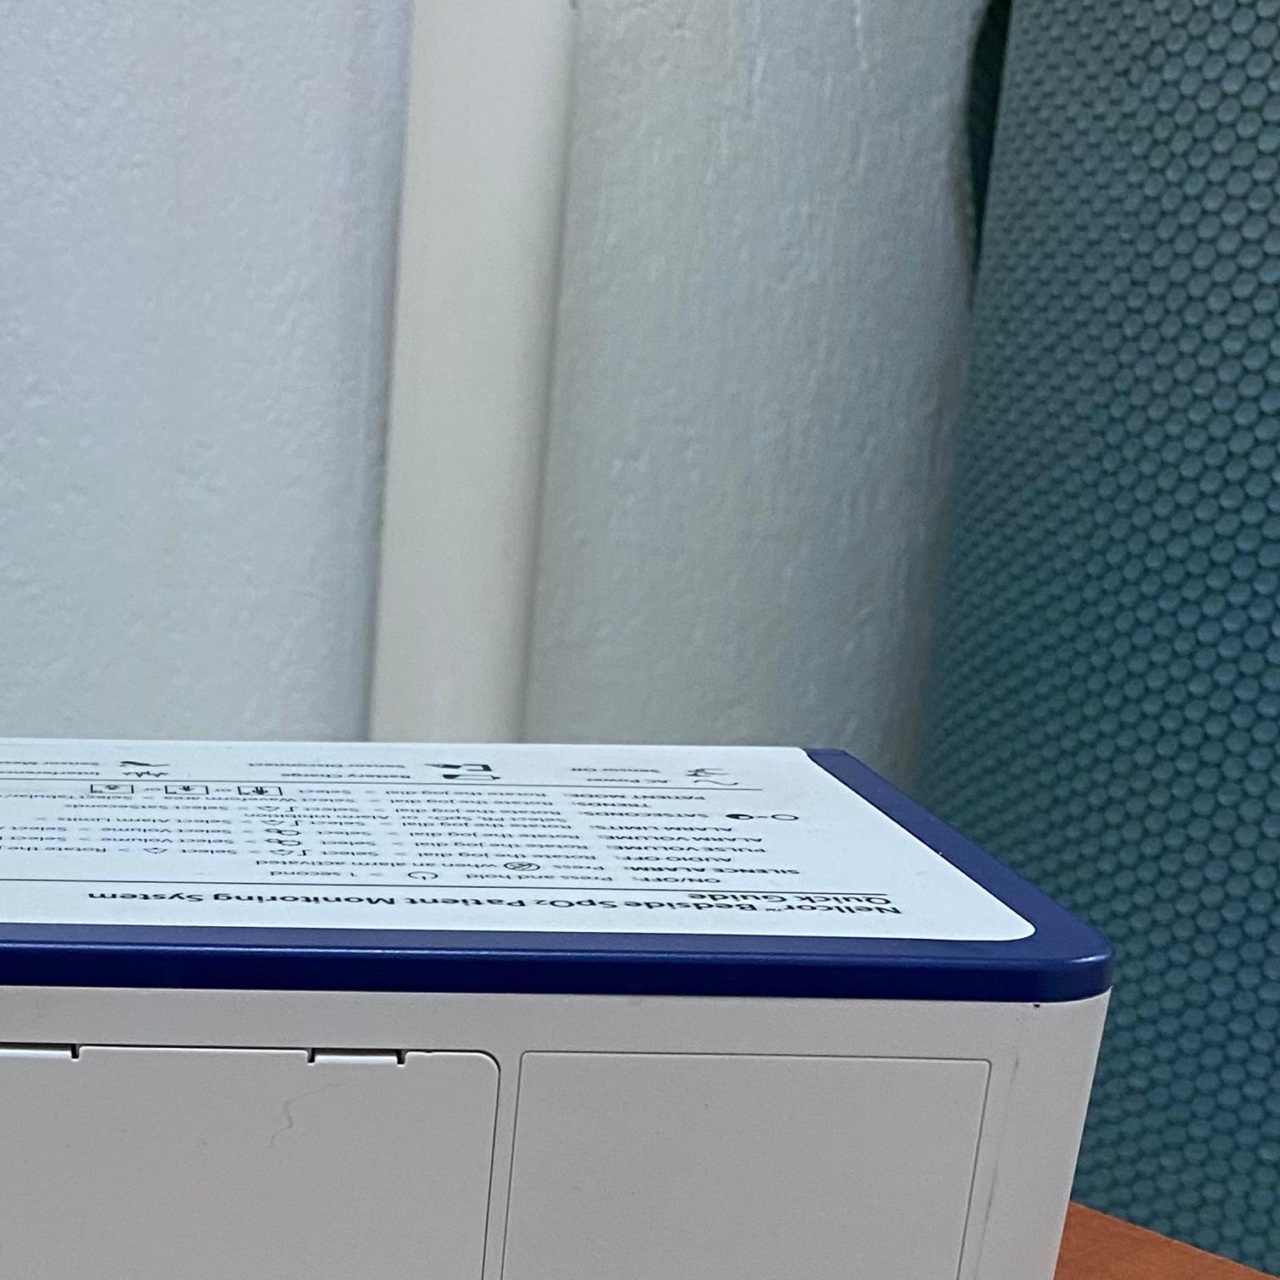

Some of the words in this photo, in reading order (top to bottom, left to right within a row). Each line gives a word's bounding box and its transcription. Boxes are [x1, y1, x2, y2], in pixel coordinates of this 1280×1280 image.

[88, 892, 203, 902] System
[213, 893, 395, 905] Monitoring
[404, 897, 526, 907] Patient
[688, 894, 787, 902] Guide
[794, 896, 891, 905] Quick
[624, 901, 757, 911] Bedside
